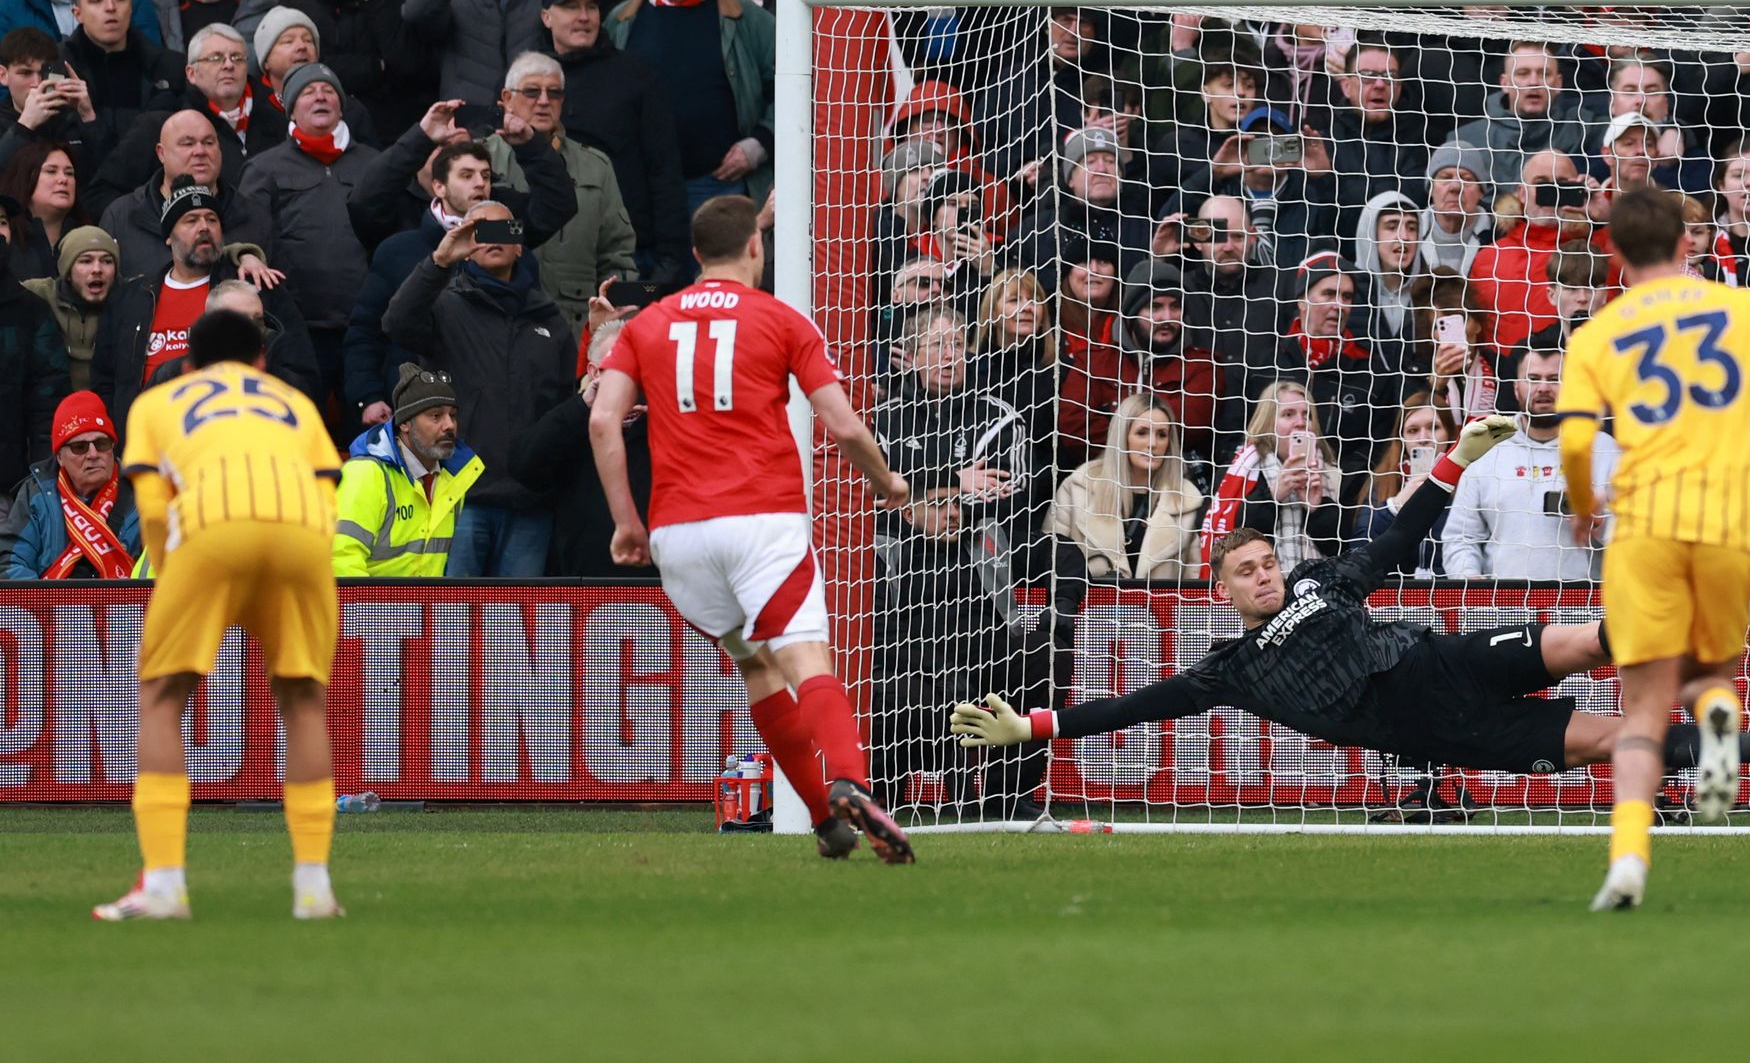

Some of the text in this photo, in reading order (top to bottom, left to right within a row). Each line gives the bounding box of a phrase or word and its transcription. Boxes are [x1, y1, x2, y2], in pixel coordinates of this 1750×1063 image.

[680, 291, 739, 310] WOOD
[668, 319, 738, 413] 11
[1614, 311, 1741, 423] 33
[171, 377, 298, 435] 25
[395, 505, 414, 522] 100
[1255, 591, 1320, 650] AMERICAN
[1271, 598, 1328, 646] EXPRESS
[1490, 631, 1523, 646] 1
